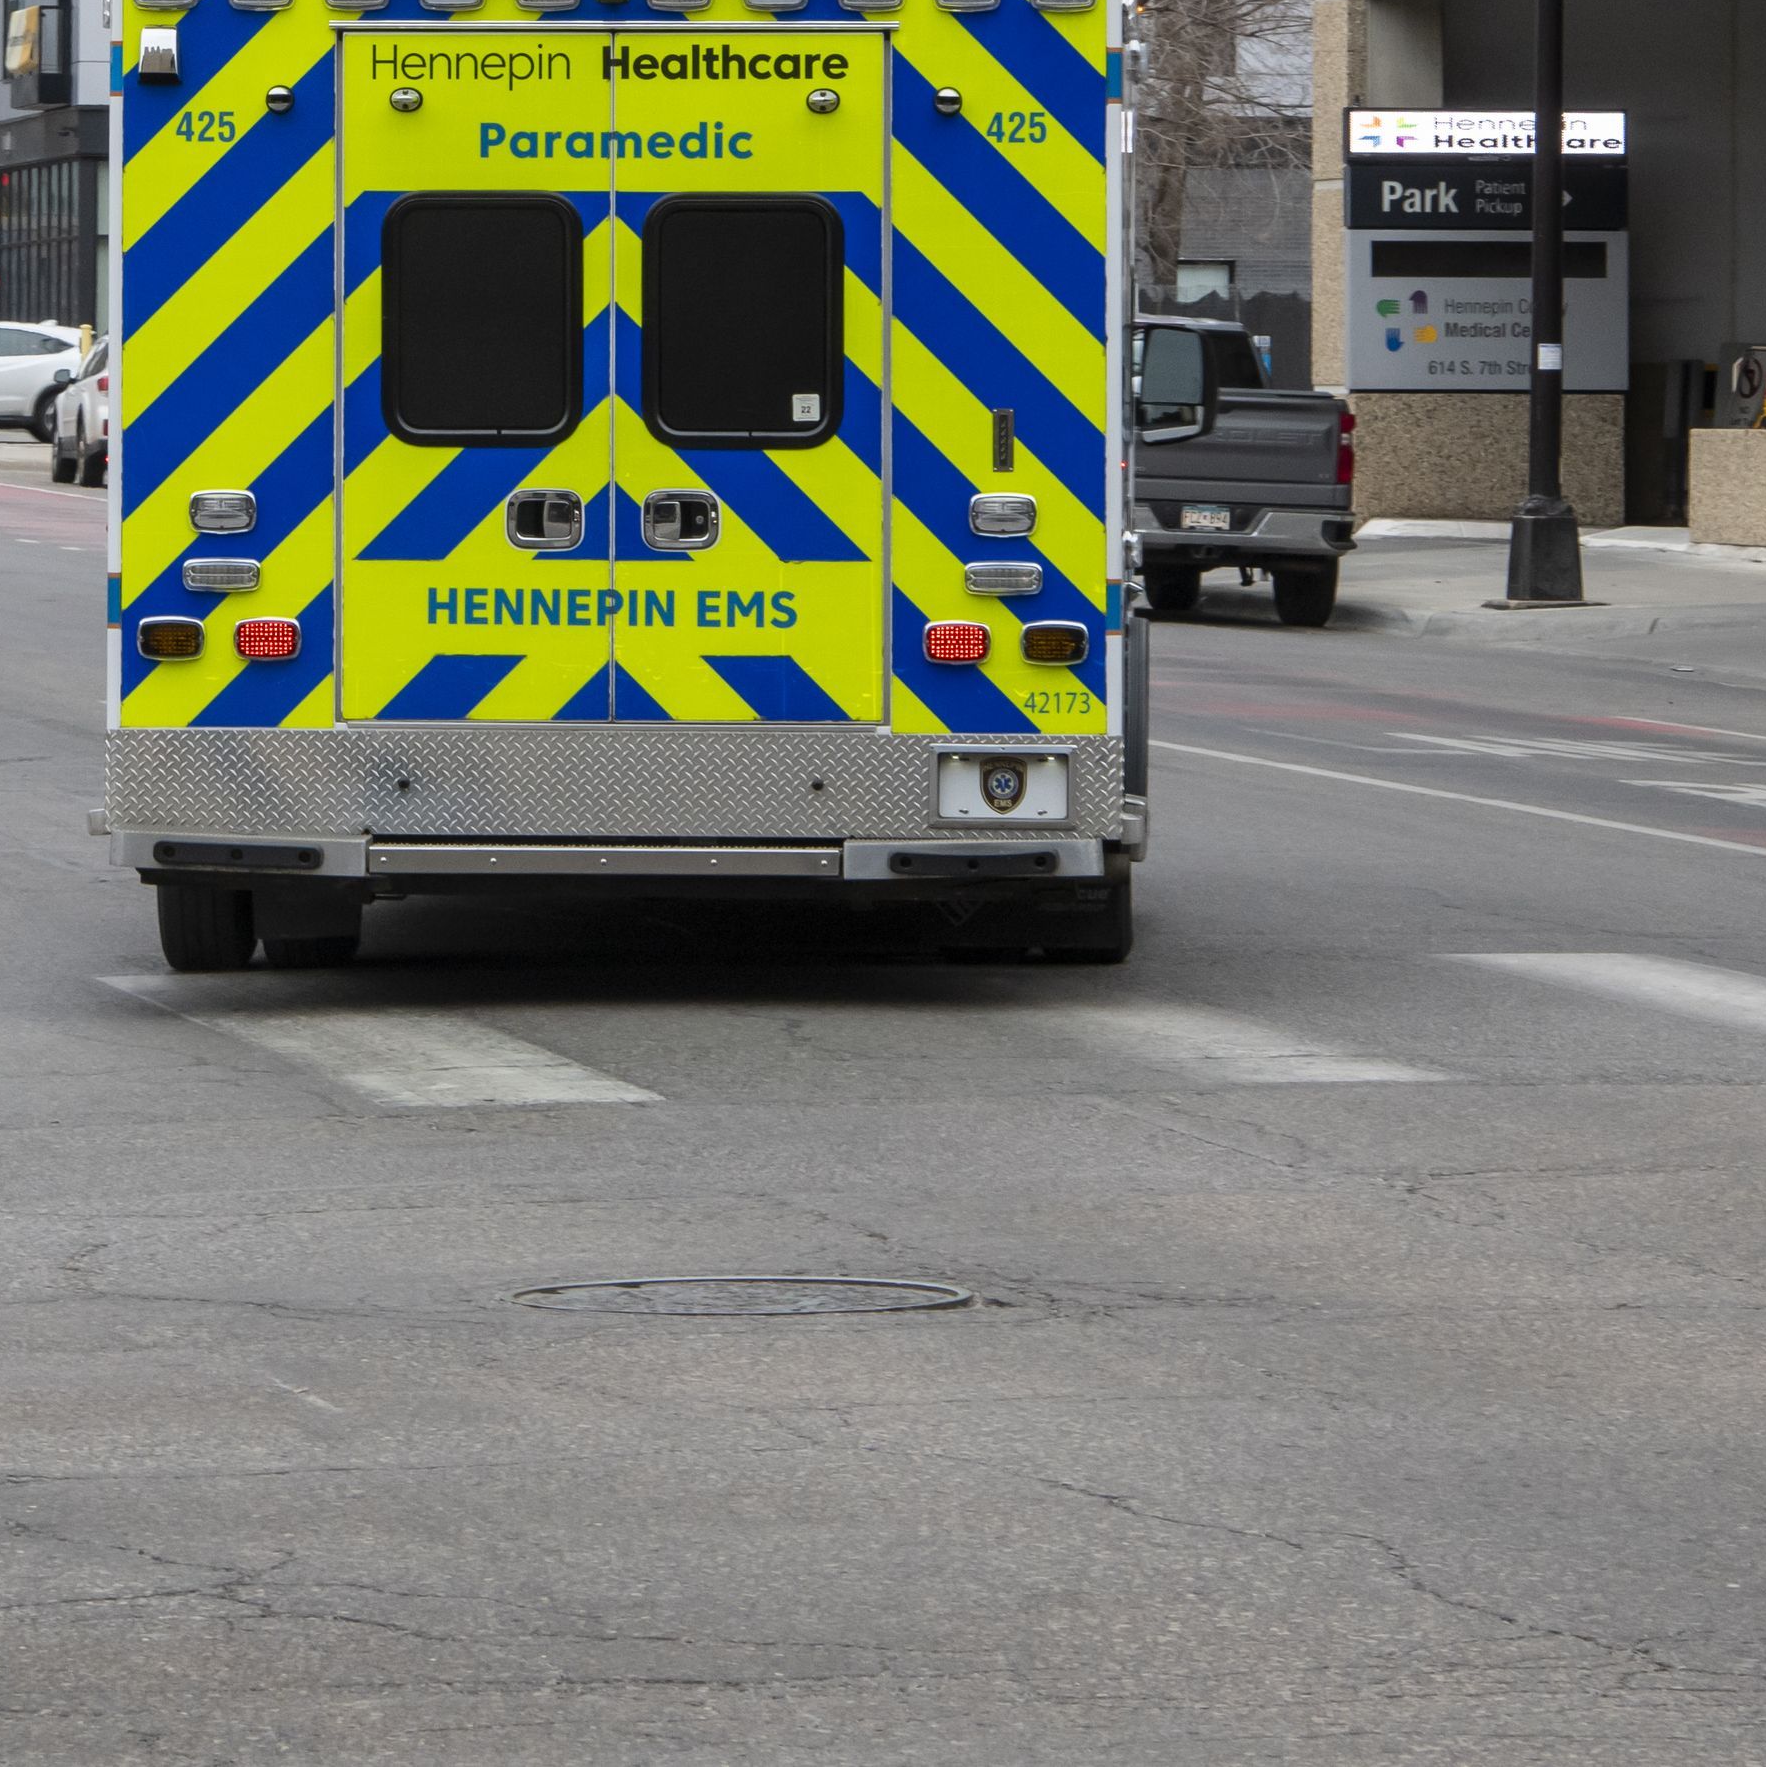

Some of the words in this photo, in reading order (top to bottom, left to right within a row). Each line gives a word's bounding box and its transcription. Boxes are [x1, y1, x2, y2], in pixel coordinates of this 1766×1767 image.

[371, 44, 570, 91] Hennepin
[602, 44, 849, 81] Healthcare
[176, 111, 237, 143] 425
[987, 112, 1047, 143] 425
[1434, 116, 1587, 133] Hennen
[479, 121, 754, 160] Paramedic
[1434, 134, 1622, 149] Healthare
[1382, 181, 1459, 213] Park
[1475, 180, 1526, 195] Patient
[1475, 199, 1523, 216] Pickup
[1445, 299, 1513, 317] Hennepin
[1445, 322, 1506, 338] Medical
[1428, 361, 1456, 375] 614
[1479, 361, 1502, 375] 7th
[427, 587, 679, 627] HENNEPIN
[697, 589, 797, 628] EMS
[1024, 692, 1091, 714] 42173
[993, 799, 1013, 808] EMS
